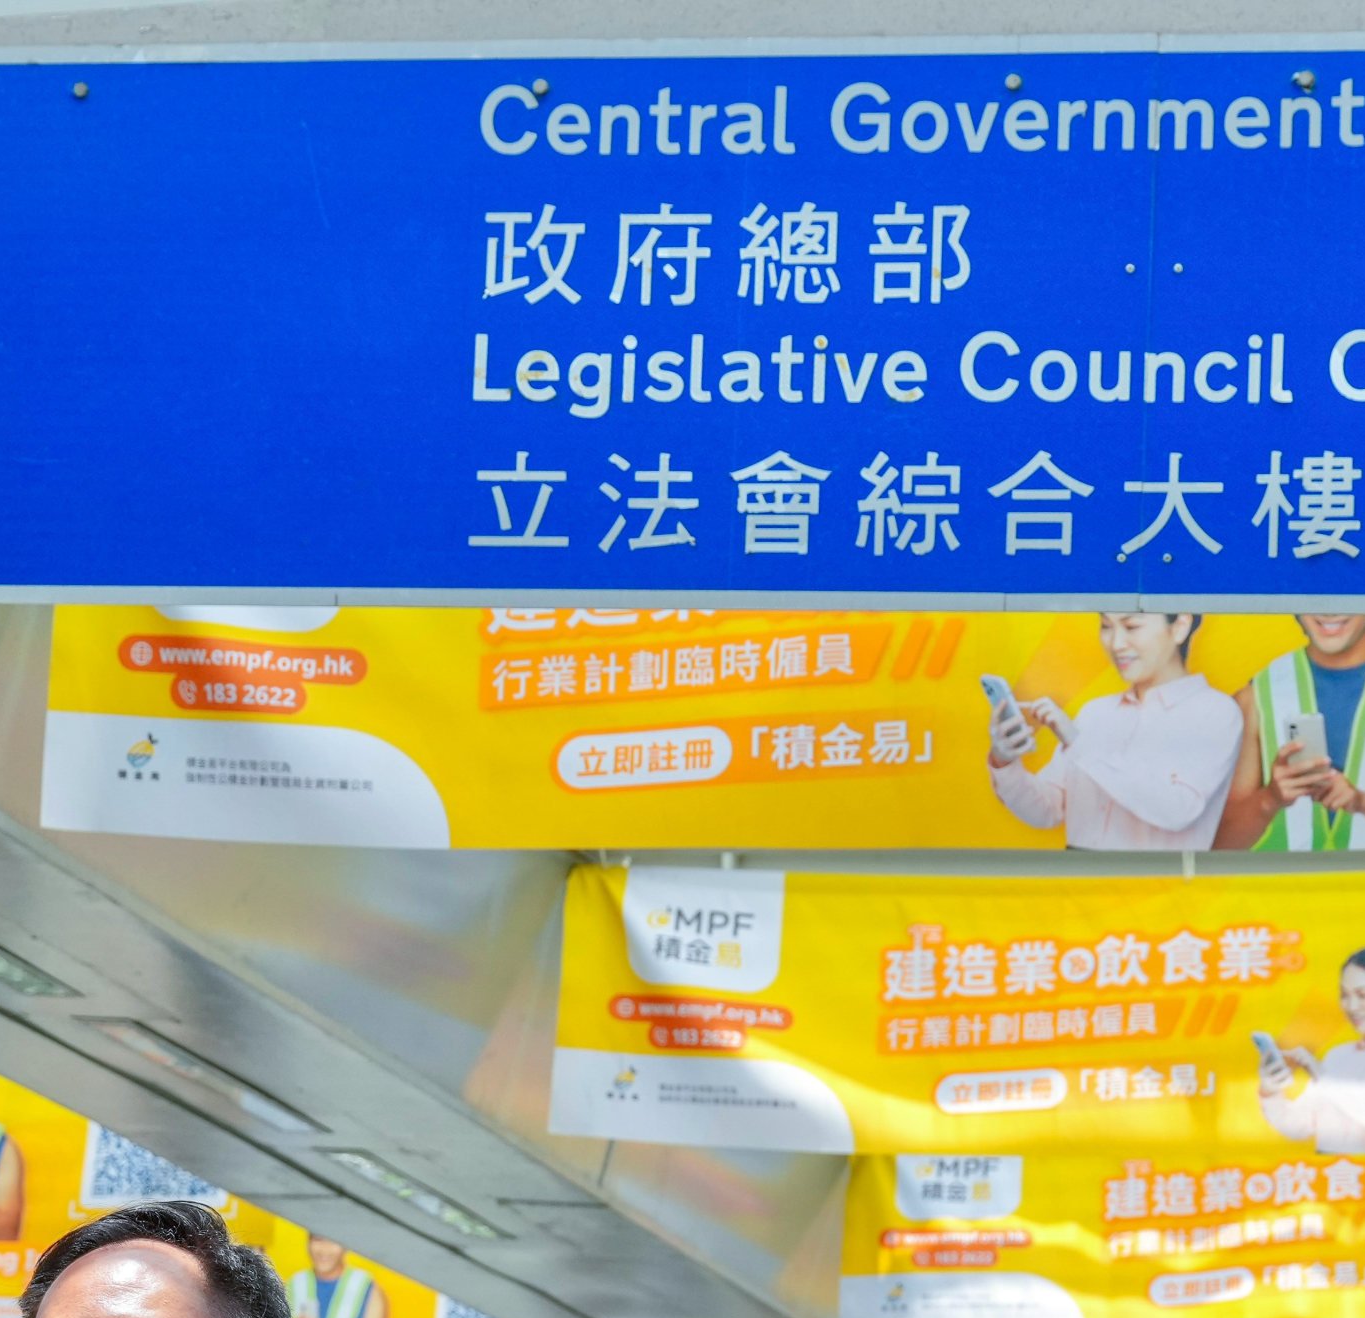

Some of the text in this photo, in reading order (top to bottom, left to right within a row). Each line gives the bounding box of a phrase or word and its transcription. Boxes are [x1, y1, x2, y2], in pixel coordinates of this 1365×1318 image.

[480, 83, 796, 155] Central
[830, 81, 1365, 154] Government
[483, 202, 971, 306] 政府總部
[472, 333, 927, 419] Legislative
[960, 331, 1293, 404] Council
[468, 450, 1362, 562] 立法會綜合大樓
[159, 647, 353, 678] www.empf.org.hk
[203, 683, 297, 707] 183 2622
[492, 633, 855, 702] 行業計劃臨時僱員
[576, 720, 933, 777] 立即註冊 「積金易」
